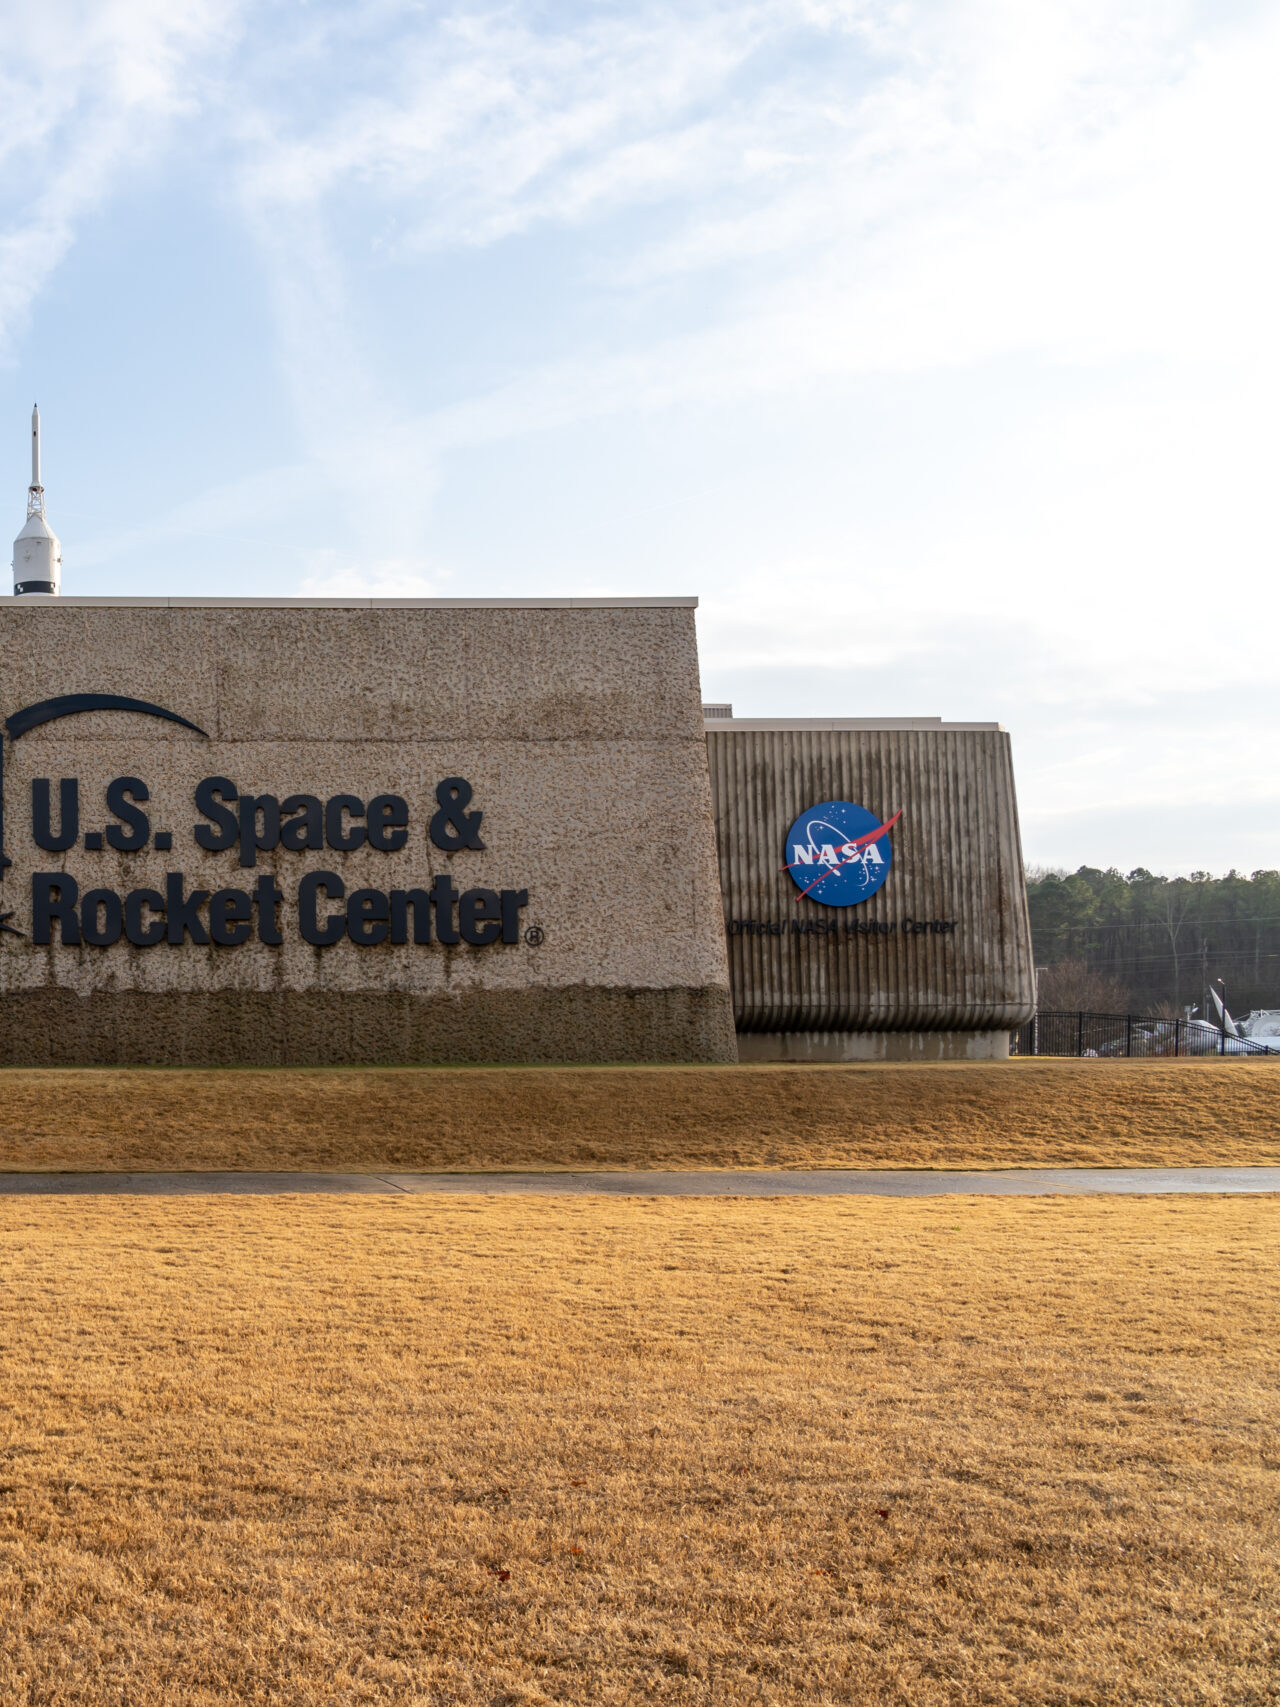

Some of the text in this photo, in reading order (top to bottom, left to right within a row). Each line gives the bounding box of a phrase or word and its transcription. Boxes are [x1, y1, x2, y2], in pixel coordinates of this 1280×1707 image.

[31, 776, 487, 867] U.S. Space &
[792, 843, 885, 865] NASA
[31, 872, 284, 946] Rocket
[728, 918, 959, 935] Official NASA Visitor Center
